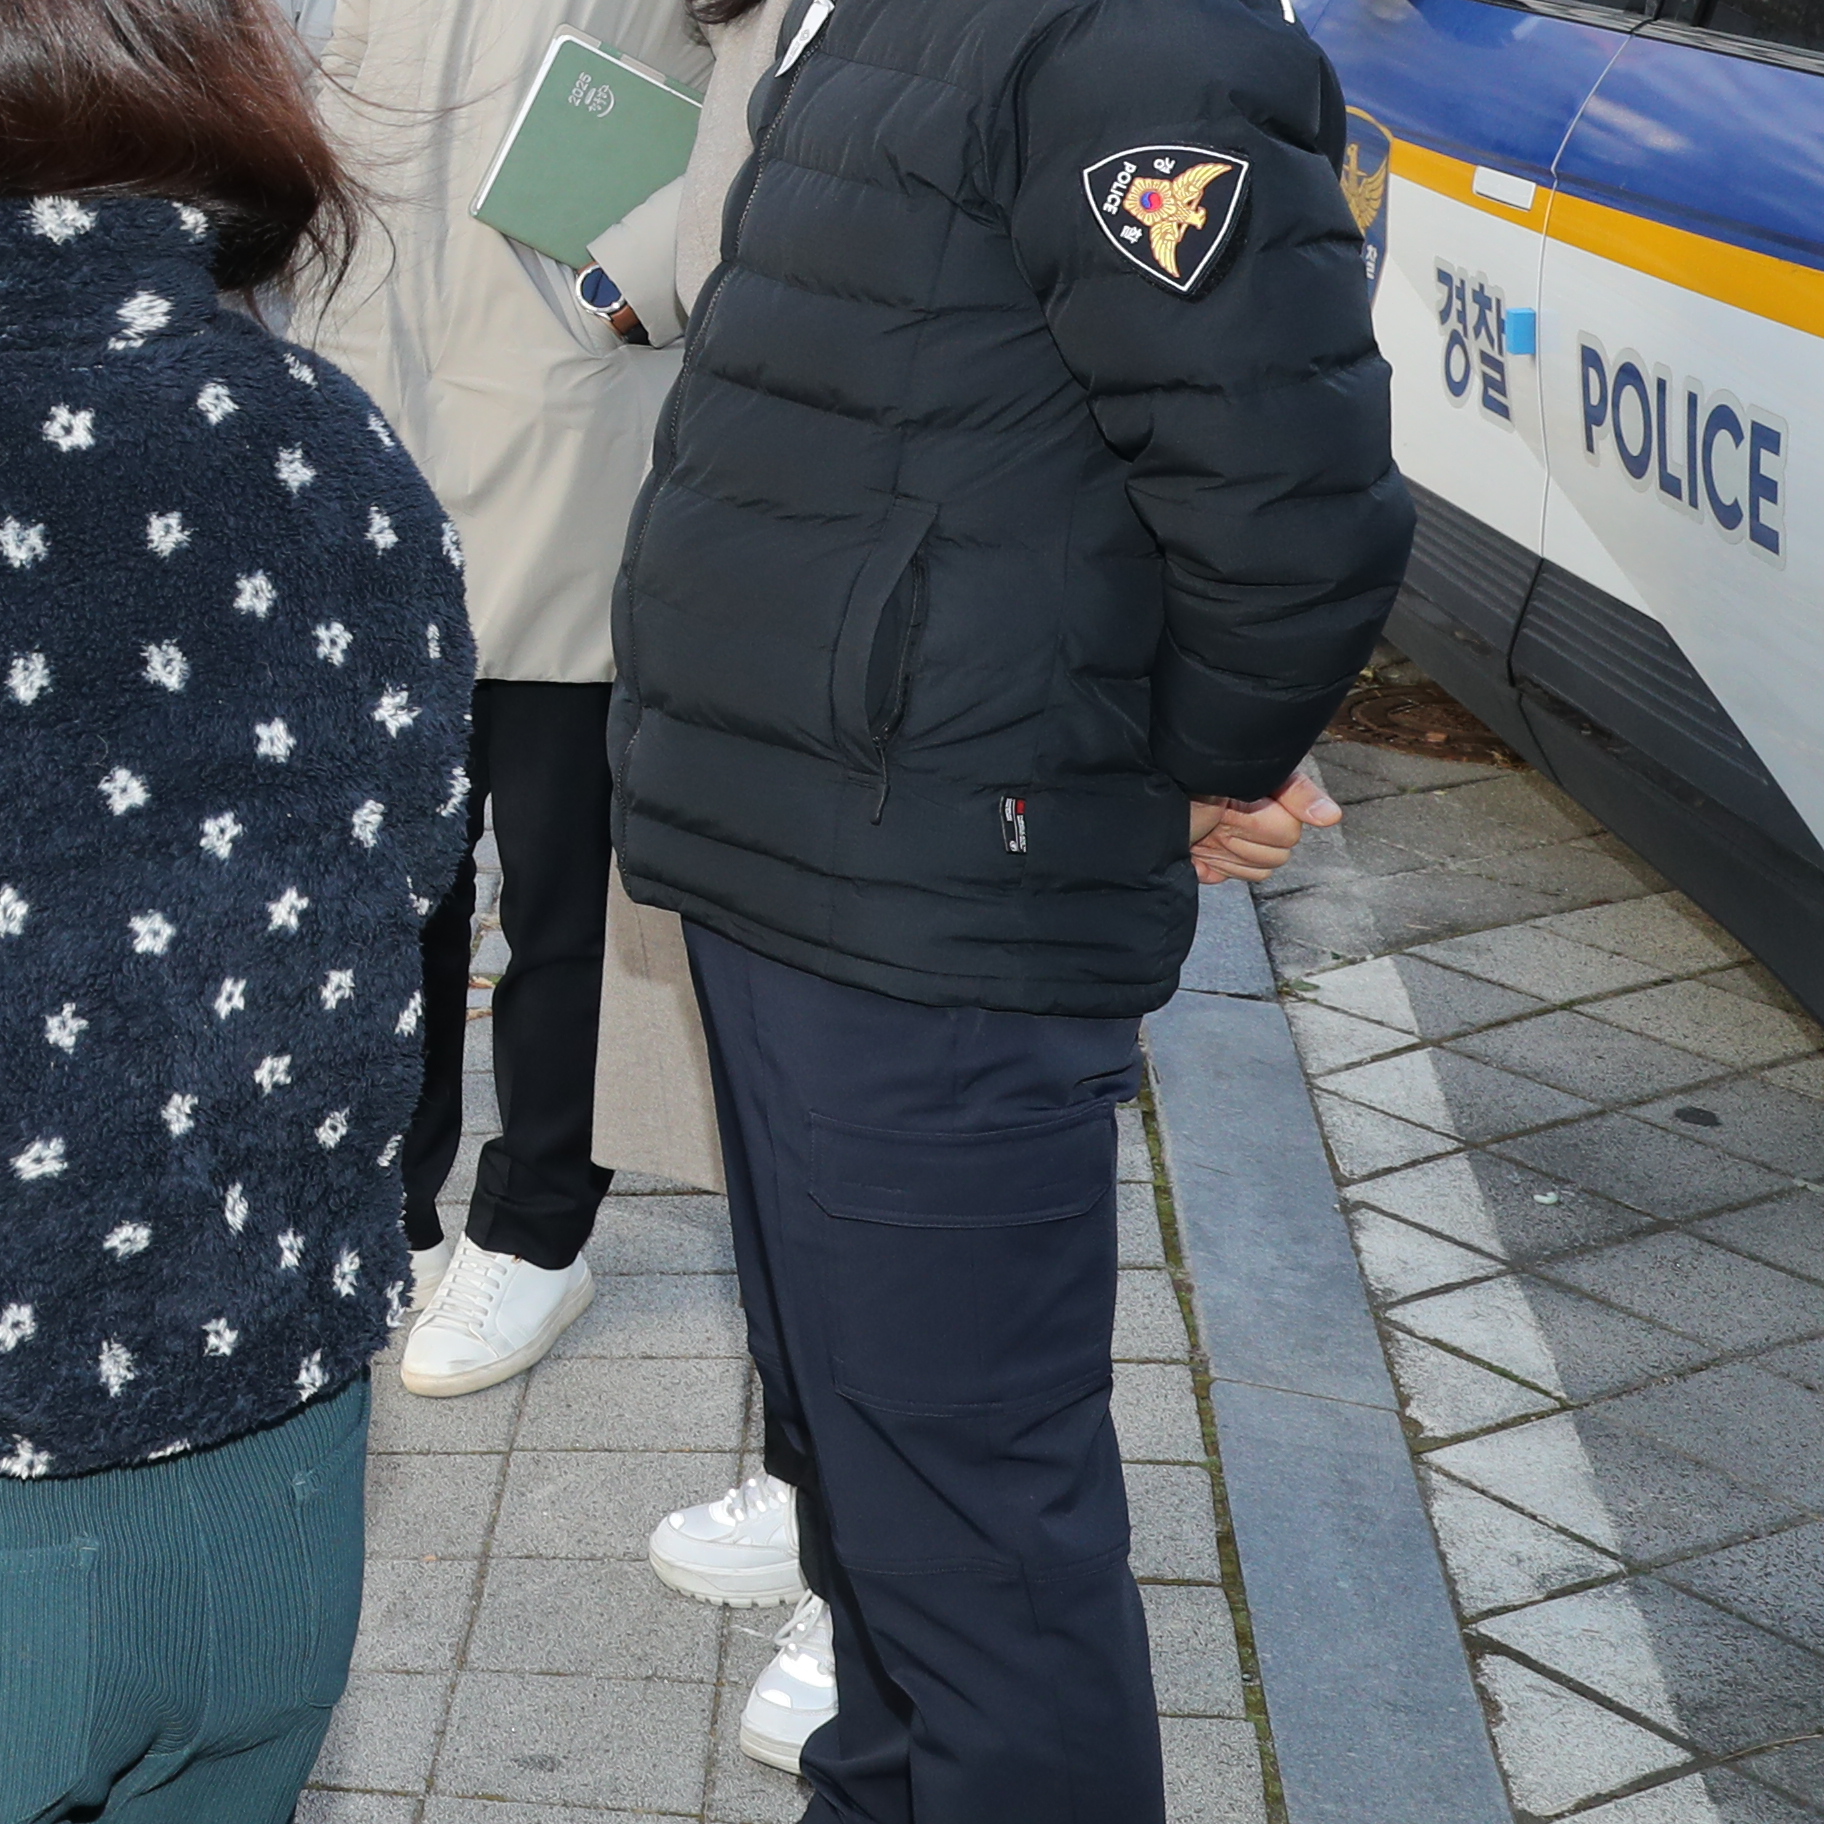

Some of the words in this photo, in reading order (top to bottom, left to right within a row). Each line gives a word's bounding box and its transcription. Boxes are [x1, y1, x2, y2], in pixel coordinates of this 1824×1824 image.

[568, 71, 592, 107] 2025
[1102, 161, 1138, 216] POLICE
[1436, 266, 1511, 422] 경찰
[1580, 343, 1782, 556] POLICE
